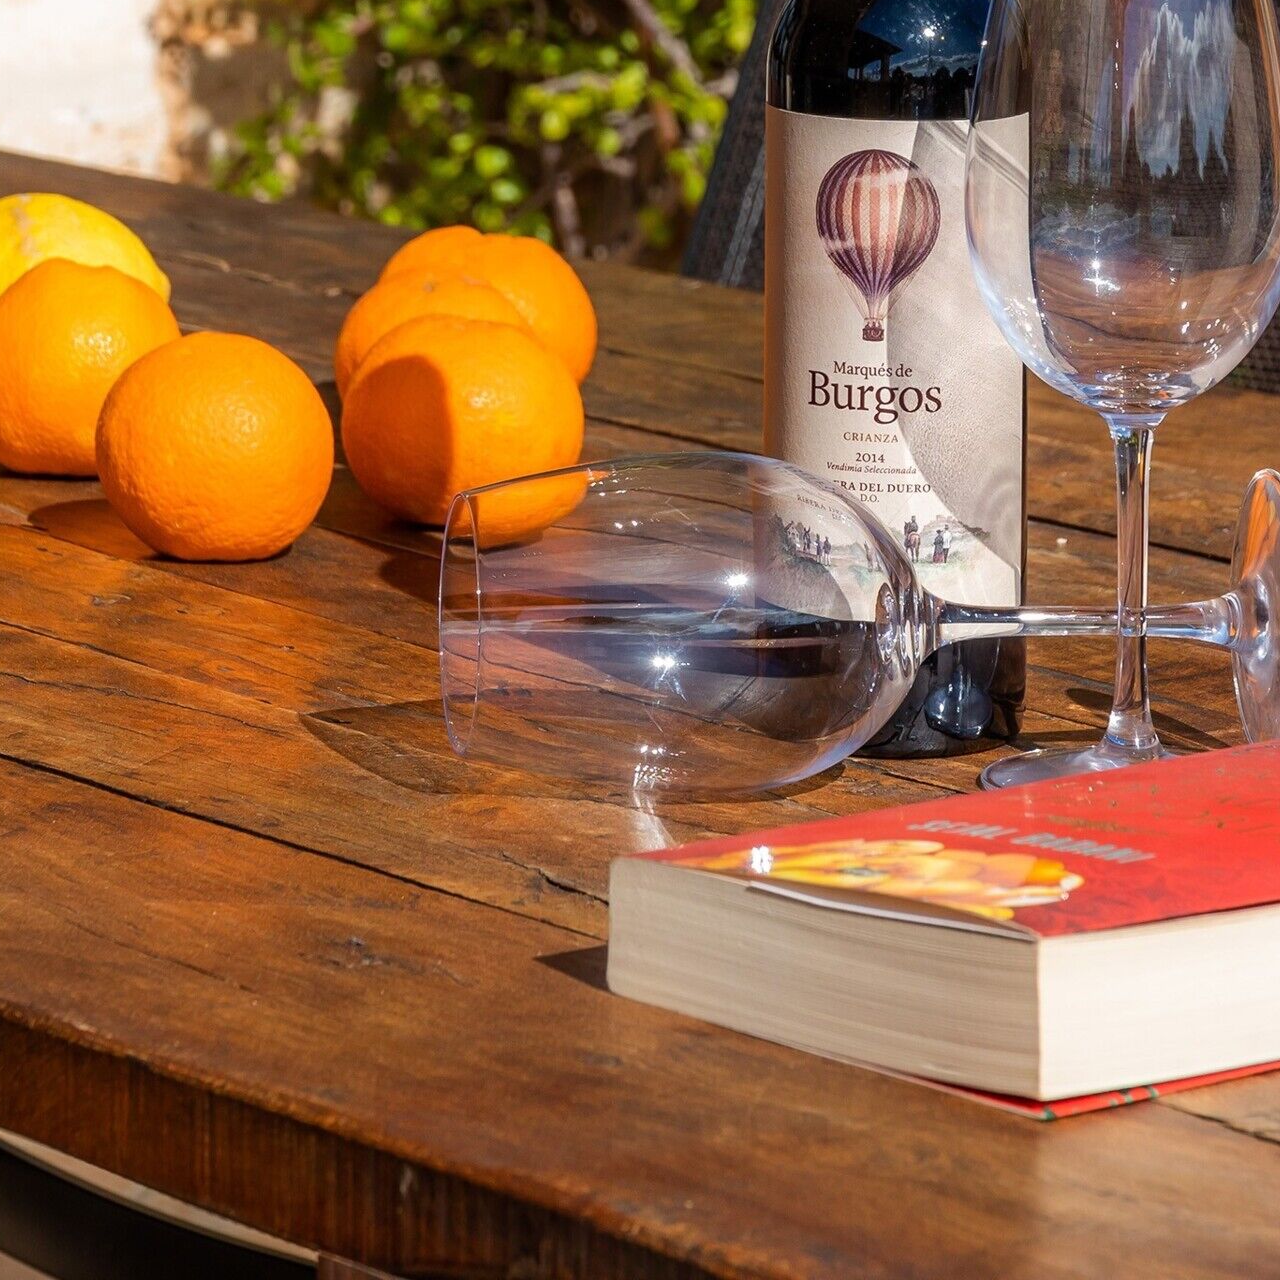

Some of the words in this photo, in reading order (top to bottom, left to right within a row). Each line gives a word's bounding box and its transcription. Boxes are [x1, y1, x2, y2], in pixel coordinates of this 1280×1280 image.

[833, 361, 893, 379] Marqués
[895, 363, 913, 378] de
[808, 370, 942, 425] Burgos
[843, 431, 899, 443] CRIANZA
[855, 452, 885, 463] 2014
[826, 461, 862, 473] Vendimia
[863, 465, 917, 475] Seleccionada
[859, 482, 884, 493] DEL
[887, 483, 931, 495] DUERO
[860, 493, 880, 503] D.O.
